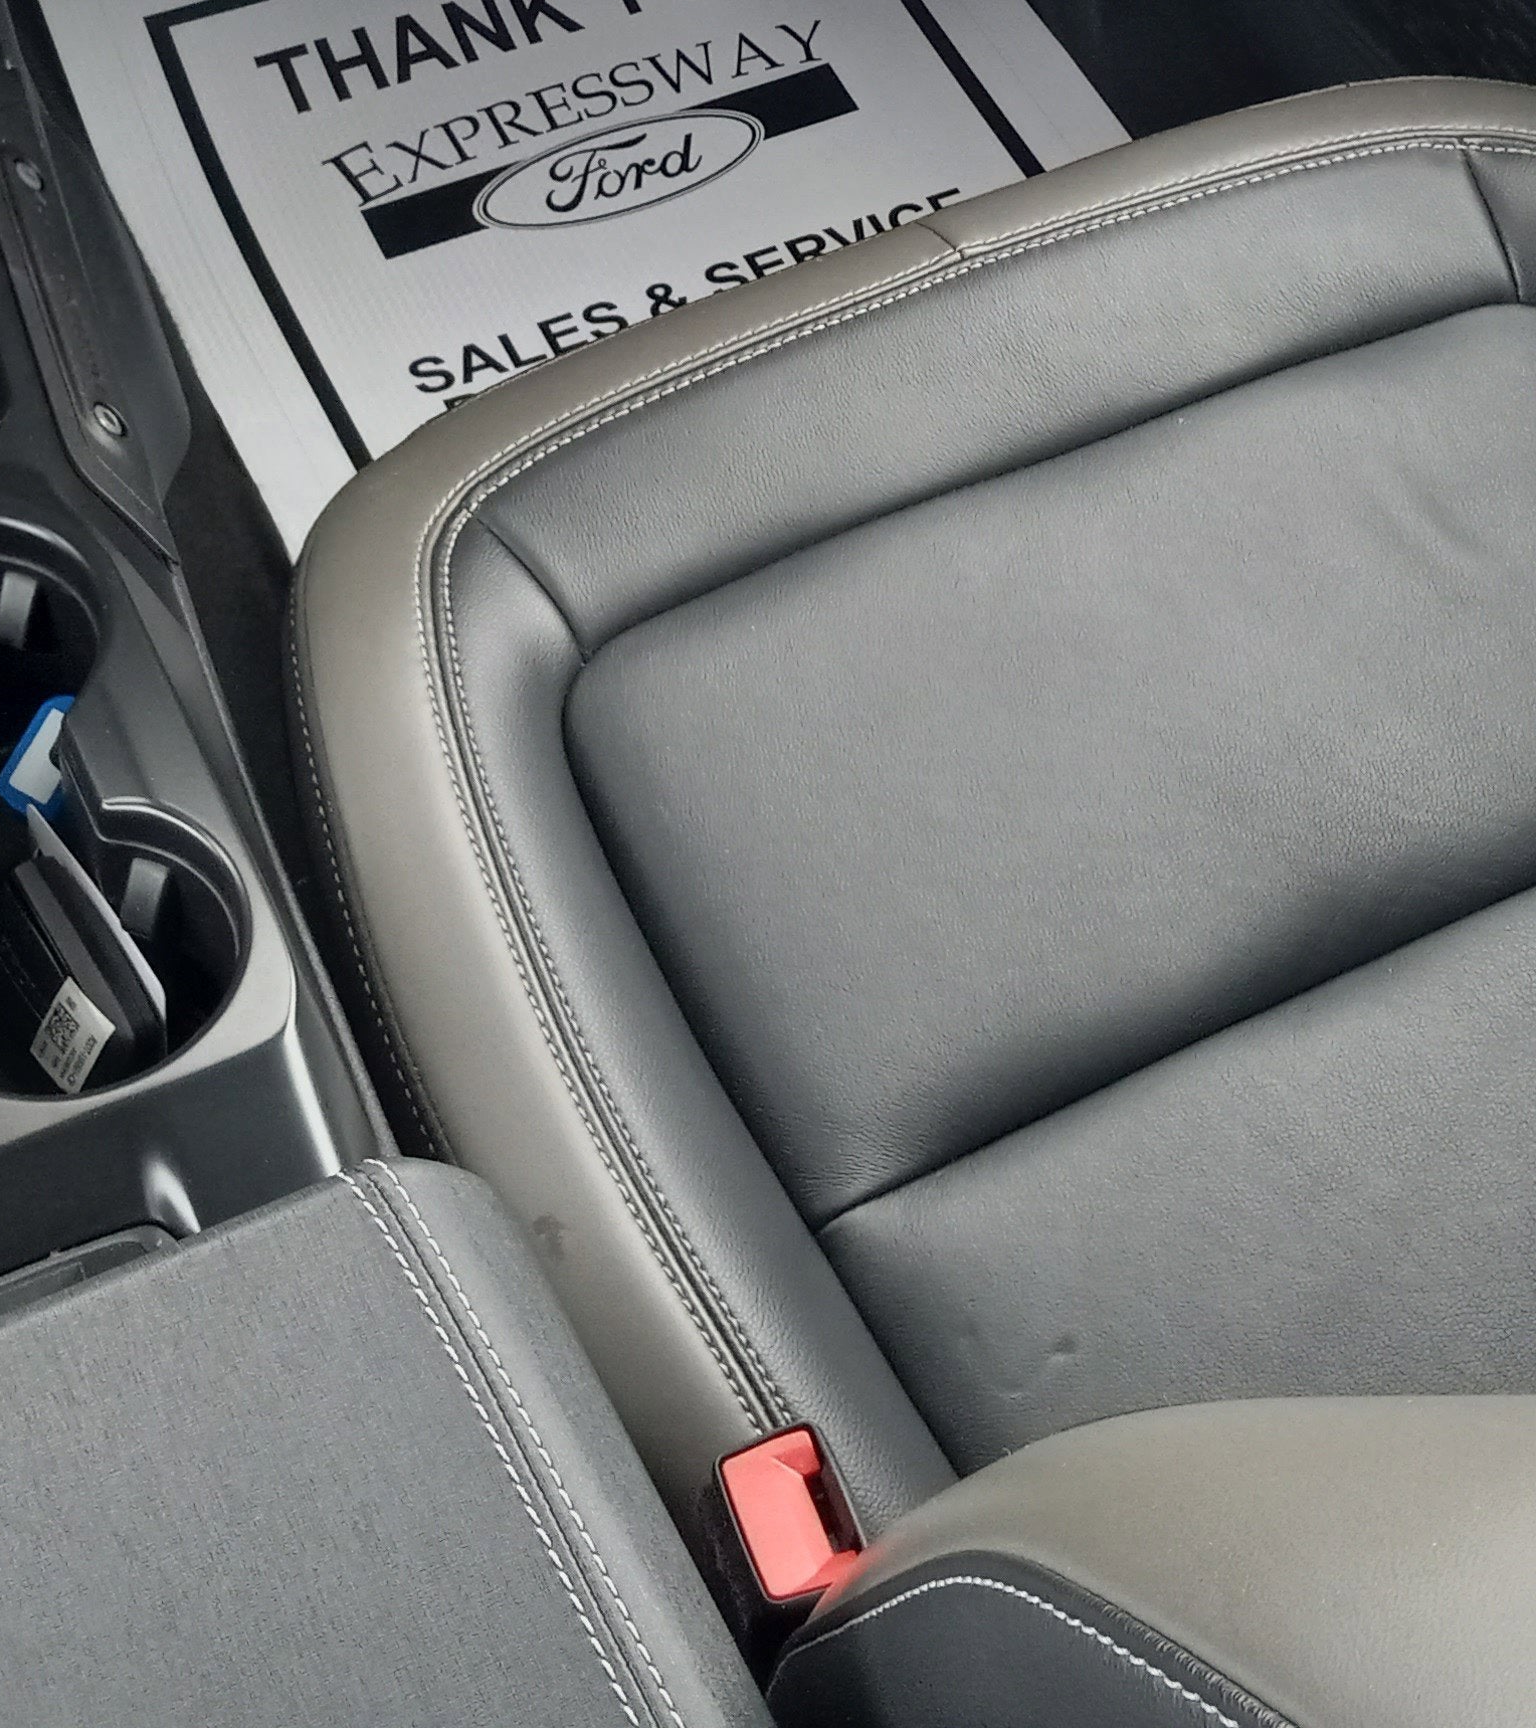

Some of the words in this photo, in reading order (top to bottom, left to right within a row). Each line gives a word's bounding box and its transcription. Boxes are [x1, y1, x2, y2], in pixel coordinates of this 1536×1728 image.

[321, 19, 825, 209] EXPRESSWAY
[544, 132, 704, 214] Ford
[406, 301, 630, 394] SALES
[646, 282, 689, 318] &
